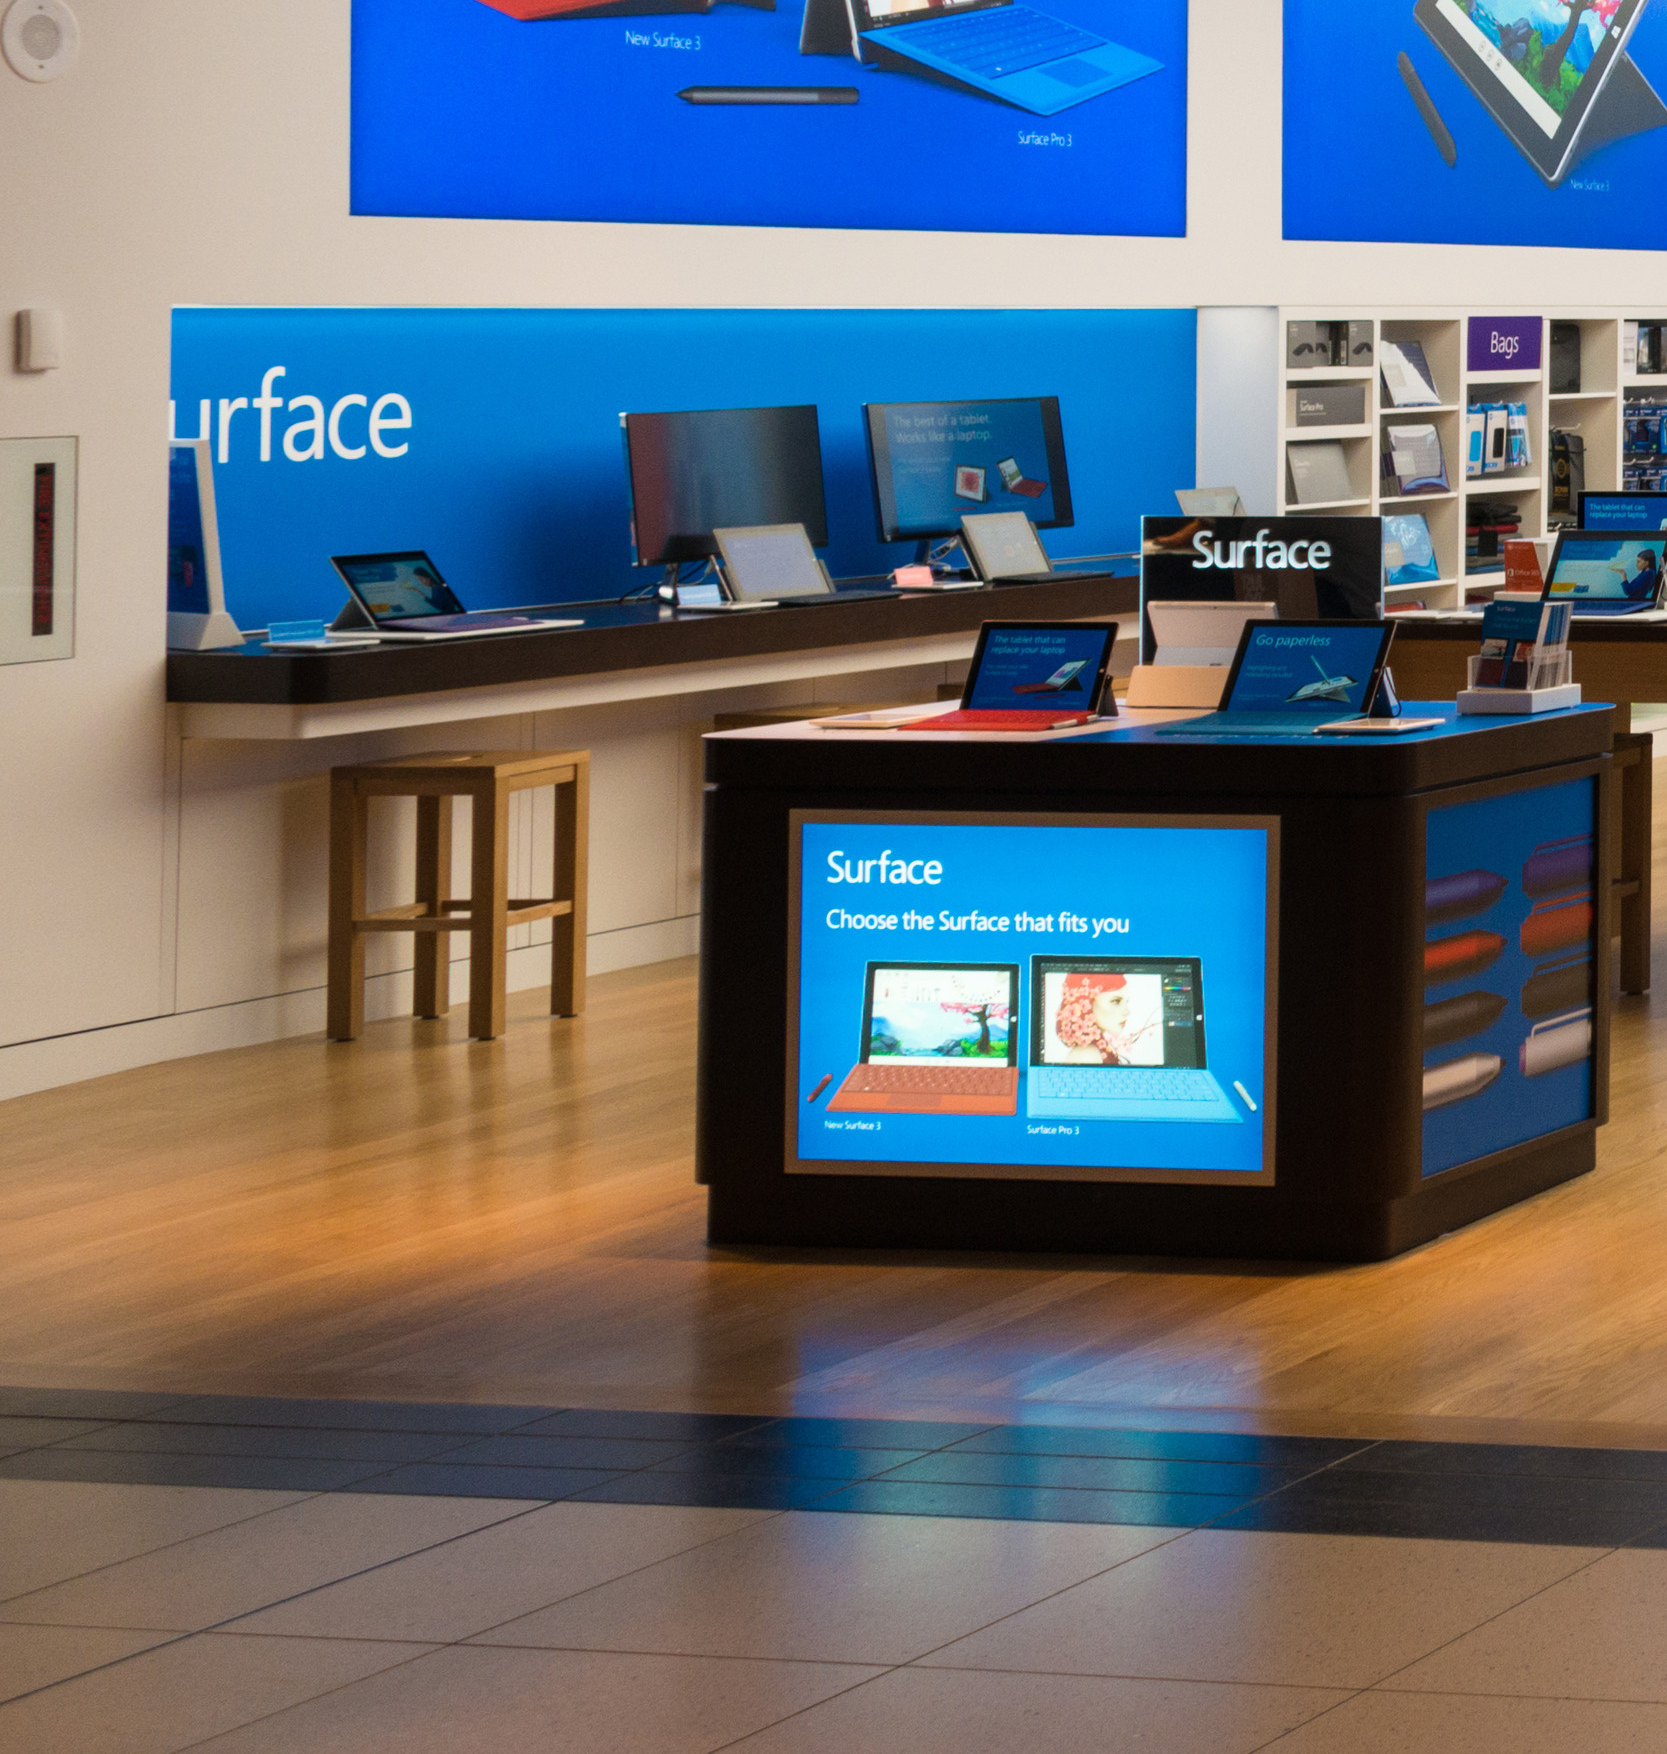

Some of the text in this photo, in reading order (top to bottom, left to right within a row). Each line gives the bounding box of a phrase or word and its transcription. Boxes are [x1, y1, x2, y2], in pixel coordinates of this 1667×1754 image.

[625, 30, 701, 50] New Surface 3
[1018, 130, 1072, 147] Surface Pro 3
[1490, 331, 1519, 359] Bags
[169, 365, 413, 464] urface
[894, 415, 911, 427] The
[914, 415, 935, 427] best
[938, 414, 948, 425] of
[895, 432, 926, 444] Works
[928, 431, 946, 443] like
[1590, 503, 1600, 511] The
[1602, 502, 1620, 511] tablet
[1621, 502, 1633, 511] that
[1590, 511, 1648, 520] replace your laptop
[1192, 528, 1332, 570] Surface
[994, 635, 1009, 644] The
[1010, 635, 1033, 644] tablet
[1034, 635, 1050, 644] that
[1256, 633, 1331, 649] Go paperless
[991, 645, 1066, 656] replace your laptop
[827, 849, 943, 885] Surface
[826, 908, 1130, 938] Choose the Surface that fits you
[824, 1120, 881, 1131] New Surface 3
[1027, 1124, 1080, 1135] Surface Pro 3
